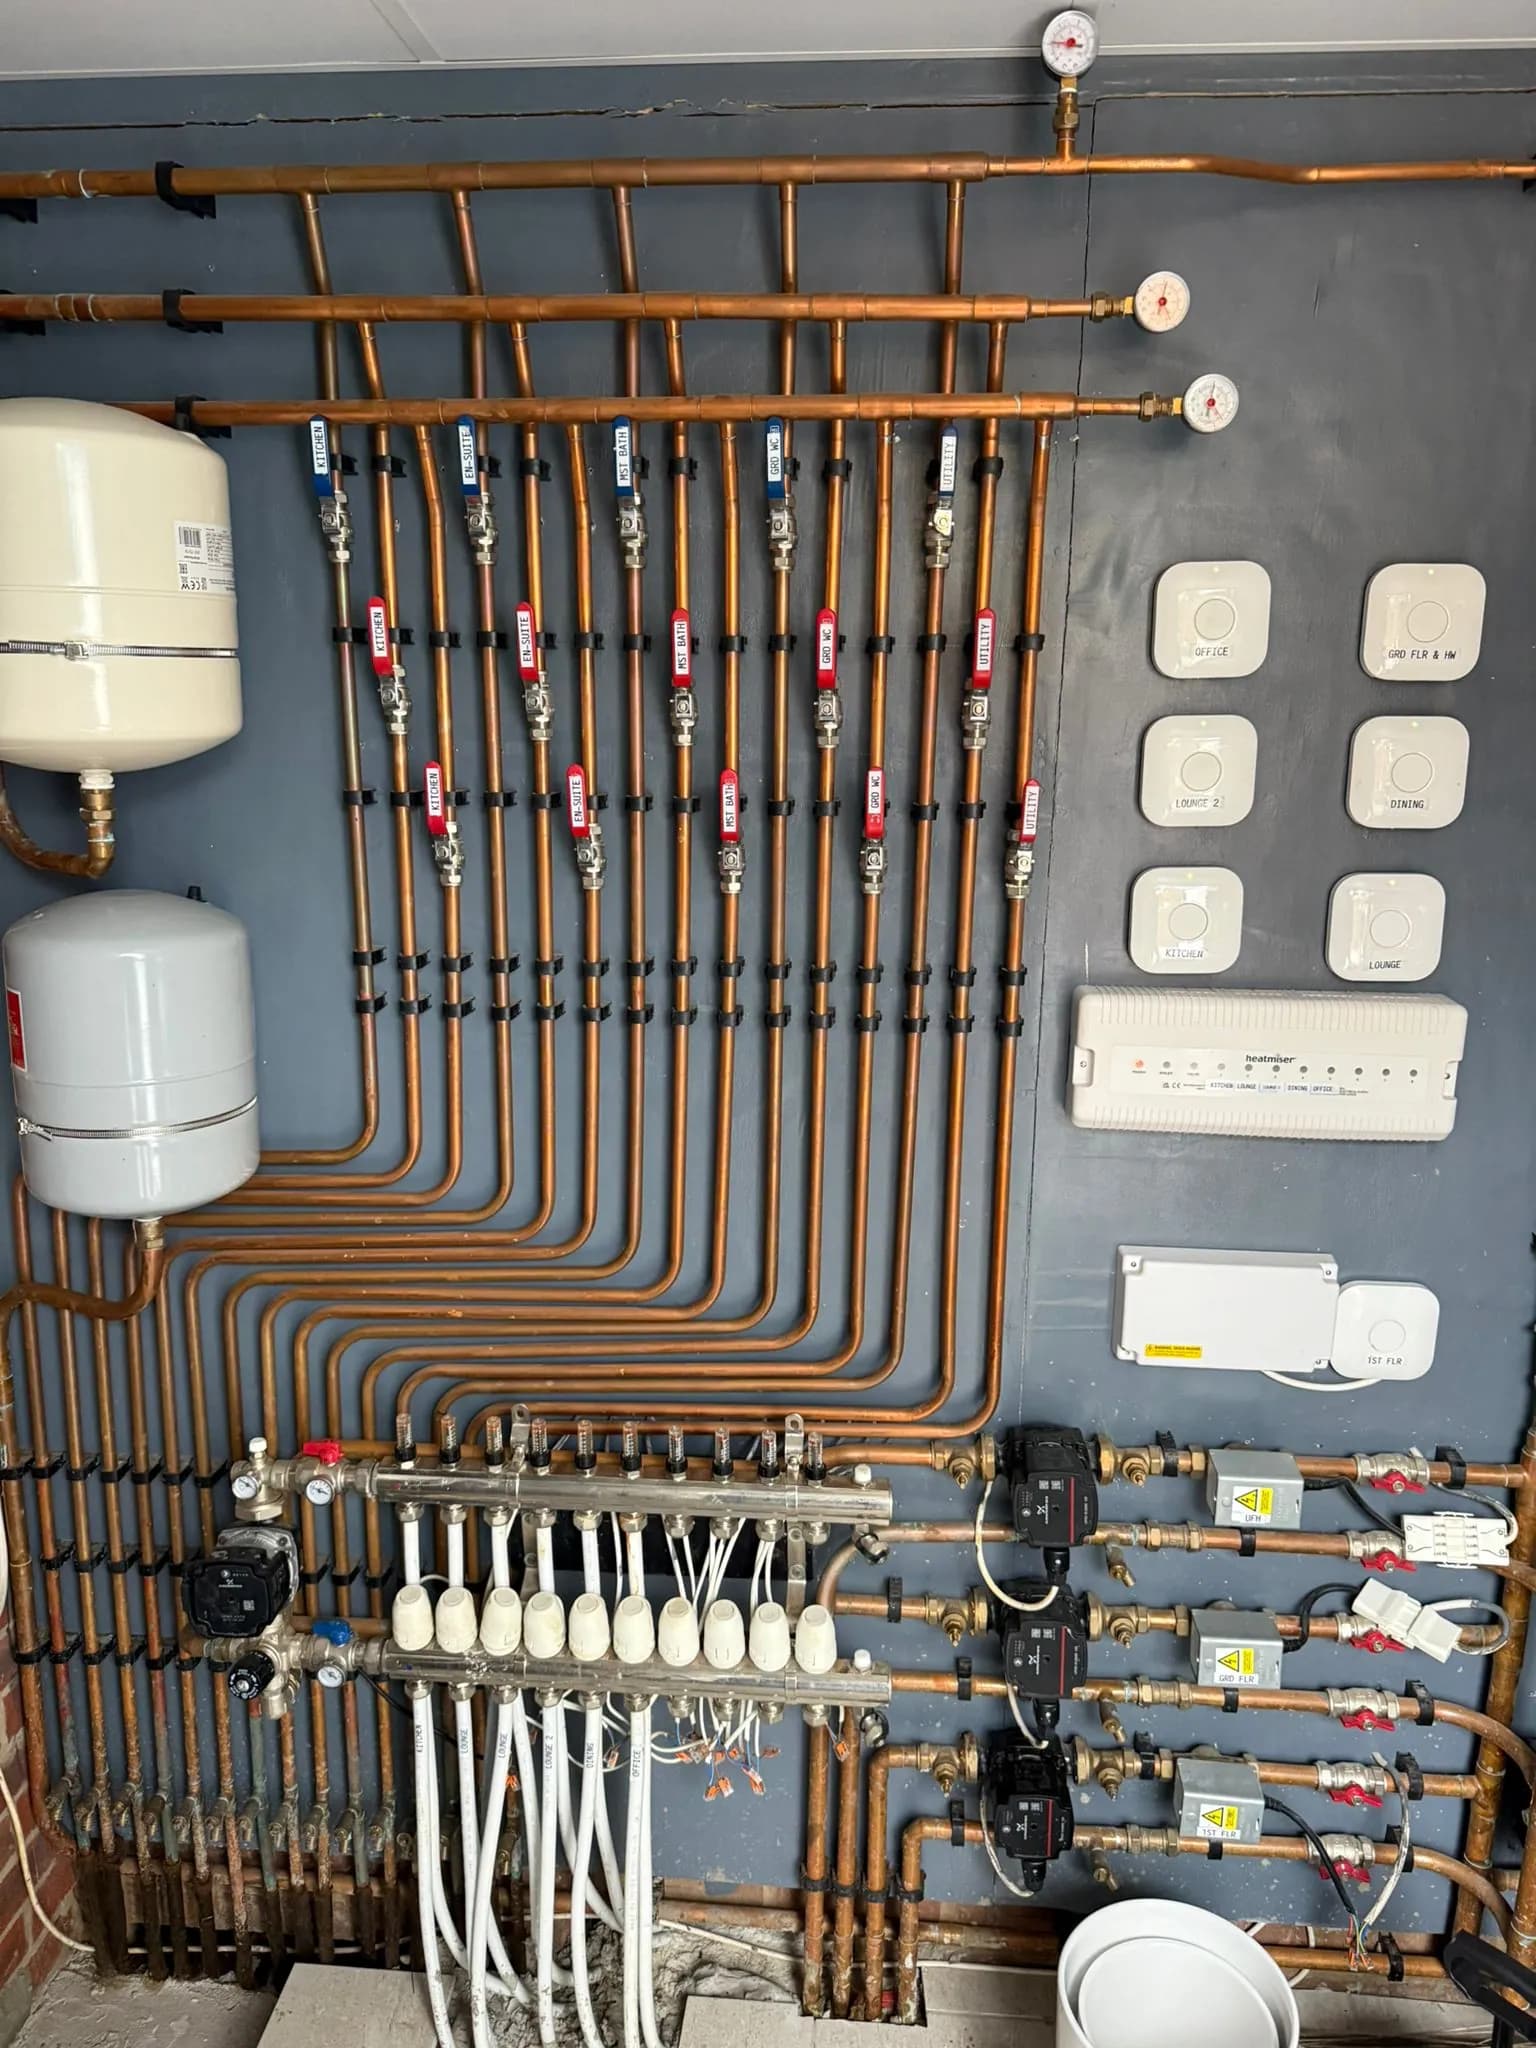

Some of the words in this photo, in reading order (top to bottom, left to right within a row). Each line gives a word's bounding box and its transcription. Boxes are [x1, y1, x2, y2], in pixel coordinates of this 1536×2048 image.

[314, 426, 327, 468] KITCHEN
[463, 430, 475, 479] EN-SUITE
[618, 431, 628, 456] BATH
[770, 437, 780, 452] WC
[619, 460, 629, 482] MST
[770, 456, 780, 475] GRD
[943, 442, 954, 486] UTILITY
[374, 611, 385, 651] KITCHEN
[520, 615, 532, 662] EN-SUITE
[677, 623, 686, 647] BATH
[823, 628, 832, 641] WC
[822, 643, 831, 663] GRD
[980, 624, 990, 664] UTILITY
[1195, 646, 1229, 657] OFFICE
[1388, 649, 1406, 660] GRD
[1410, 649, 1429, 660] FLR
[1433, 649, 1439, 660] &
[678, 649, 687, 669] MST
[430, 772, 440, 811] KITCHEN
[871, 776, 880, 787] WC
[573, 778, 583, 822] EN-SUITE
[725, 784, 734, 806] BATH
[871, 791, 880, 808] GRD
[1175, 799, 1208, 809] LOUNGE
[1213, 799, 1219, 808] 2
[1390, 799, 1424, 809] DINING
[726, 809, 734, 828] MST
[1026, 791, 1036, 830] UTILITY
[1165, 948, 1203, 958] KITCHEN
[1369, 960, 1401, 970] LOUNGE
[1245, 1054, 1294, 1064] heatmiser
[1368, 1356, 1382, 1365] 1ST
[1387, 1357, 1402, 1366] FLR
[460, 1728, 469, 1754] LOUNGE
[498, 1733, 508, 1758] LOUNGE
[544, 1744, 553, 1769] LOUNGE
[586, 1743, 594, 1768] DINING
[632, 1750, 641, 1777] OFFICE
